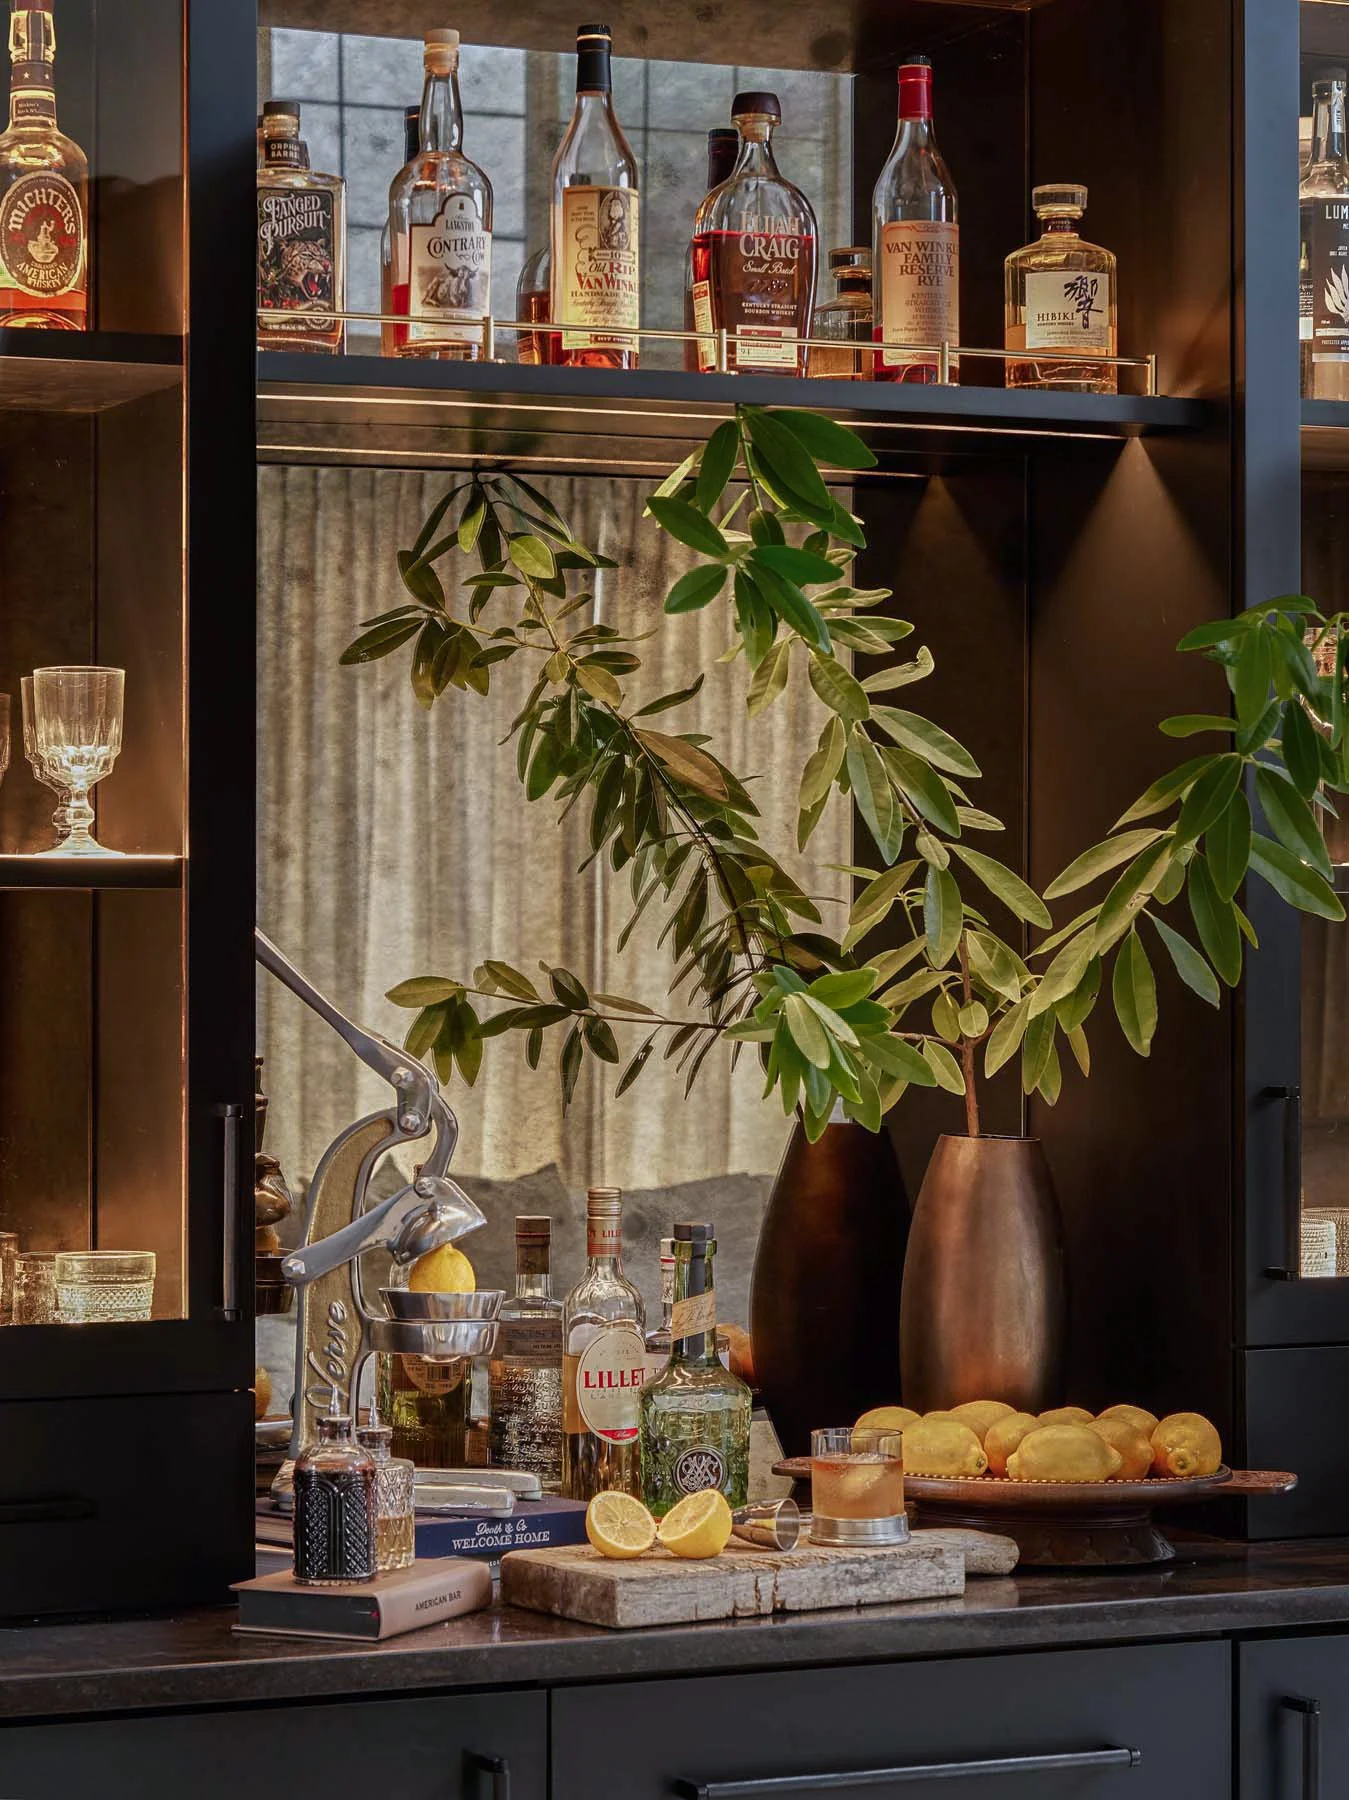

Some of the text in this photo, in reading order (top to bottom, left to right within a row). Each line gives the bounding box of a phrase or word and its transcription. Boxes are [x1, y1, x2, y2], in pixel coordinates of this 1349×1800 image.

[8, 187, 76, 235] MICHTER'S
[263, 193, 321, 221] FANGED
[260, 210, 331, 255] PURSUIT
[740, 211, 800, 235] ELIJAH
[426, 235, 487, 259] CONTRARY
[739, 233, 801, 260] CRAIG
[886, 240, 958, 255] VAN WINKL
[742, 260, 797, 275] Small Batch
[904, 252, 953, 265] FAMILY
[16, 262, 70, 280] AMERICAN
[899, 264, 955, 278] RESERVE
[27, 276, 62, 289] WHISKEY
[917, 275, 944, 287] RYE
[1037, 312, 1075, 322] HIBIKI
[583, 1367, 646, 1389] LILLET
[475, 1518, 529, 1536] Death & Co
[451, 1530, 550, 1550] WELCOME HOME
[415, 1590, 461, 1610] AMERICAN BAR
